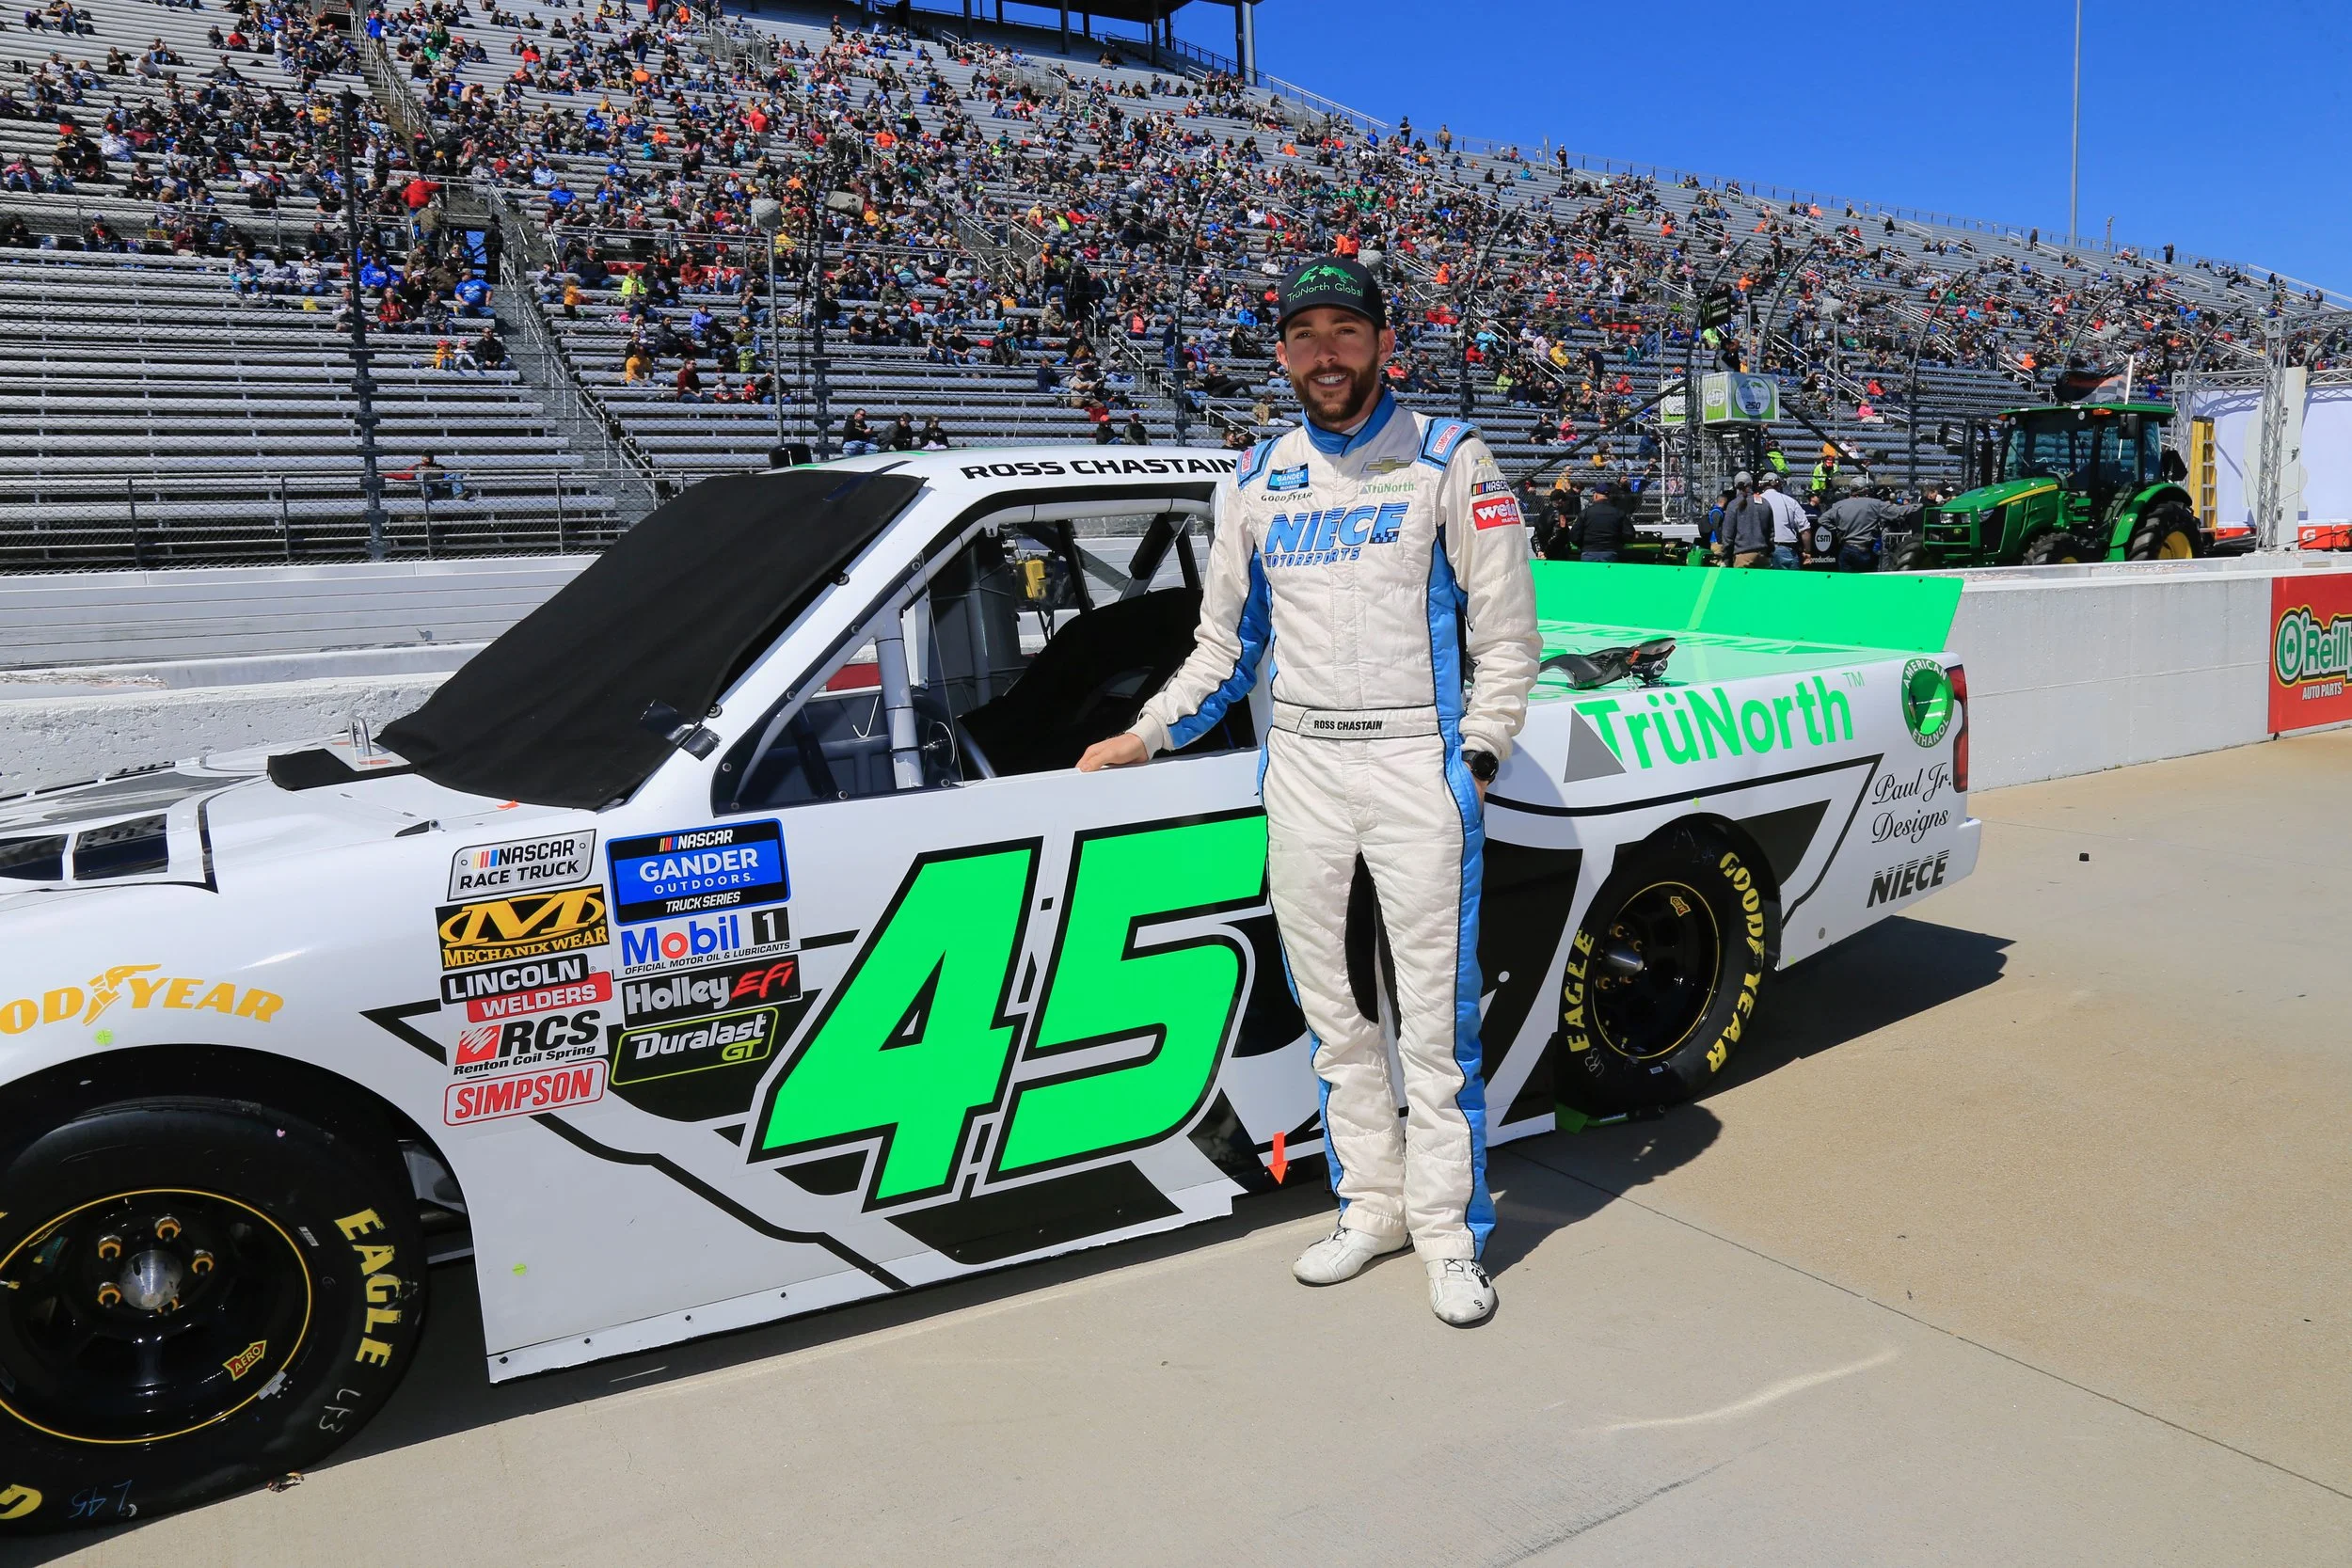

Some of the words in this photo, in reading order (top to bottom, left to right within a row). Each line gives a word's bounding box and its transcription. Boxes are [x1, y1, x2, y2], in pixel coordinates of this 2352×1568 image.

[1334, 282, 1363, 297] Global
[1745, 402, 1761, 410] 250
[1435, 426, 1460, 452] SIMPSON
[960, 461, 1066, 480] ROSS
[1070, 458, 1237, 475] CHASTAIN
[1277, 471, 1305, 483] GANDER
[1265, 502, 1409, 554] NIECE
[1816, 534, 1831, 543] csm
[1266, 546, 1361, 568] MOTORSPORTS
[1902, 658, 1947, 689] AMERICAN
[2302, 687, 2321, 701] AUTO
[2321, 681, 2343, 698] PARTS
[1314, 721, 1335, 730] ROSS
[1337, 721, 1383, 731] CHASTAIN
[1575, 675, 1854, 768] TrüNorth
[1911, 718, 1949, 748] ETHANOL
[1872, 768, 1924, 805] Paul
[1922, 762, 1952, 802] Jr.
[677, 830, 734, 850] NASCAR
[1872, 809, 1951, 844] Designs
[497, 838, 576, 866] NASCAR
[639, 847, 759, 883] GANDER
[459, 869, 511, 891] RACE
[517, 859, 580, 880] TRUCK
[653, 874, 755, 895] OUTDOORS
[1867, 849, 1950, 909] NIECE
[666, 895, 702, 913] TRUCK
[701, 892, 741, 910] SERIES
[443, 942, 549, 969] MECHANIX
[548, 926, 609, 953] WEAR
[620, 914, 740, 967] Mobil
[761, 911, 778, 942] 1
[625, 962, 667, 975] OFFICIAL
[669, 956, 704, 969] MOTOR
[706, 953, 721, 962] OIL
[723, 951, 731, 959] &
[733, 942, 791, 958] LUBRICANTS
[448, 958, 581, 1000] LINCOLN
[626, 975, 730, 1015] Holley
[1565, 927, 1596, 1053] EAGLE
[481, 984, 597, 1018] WELDERS
[753, 810, 1267, 1208] 45
[499, 1009, 601, 1058] RCS
[629, 1014, 768, 1060] Duralast
[453, 1056, 509, 1075] Renton
[513, 1052, 543, 1066] Coil
[546, 1045, 596, 1063] Spring
[721, 1038, 763, 1063] GT
[453, 1068, 596, 1120] SIMPSON
[335, 1207, 403, 1368] EAGLE
[234, 1346, 261, 1372] AERO
